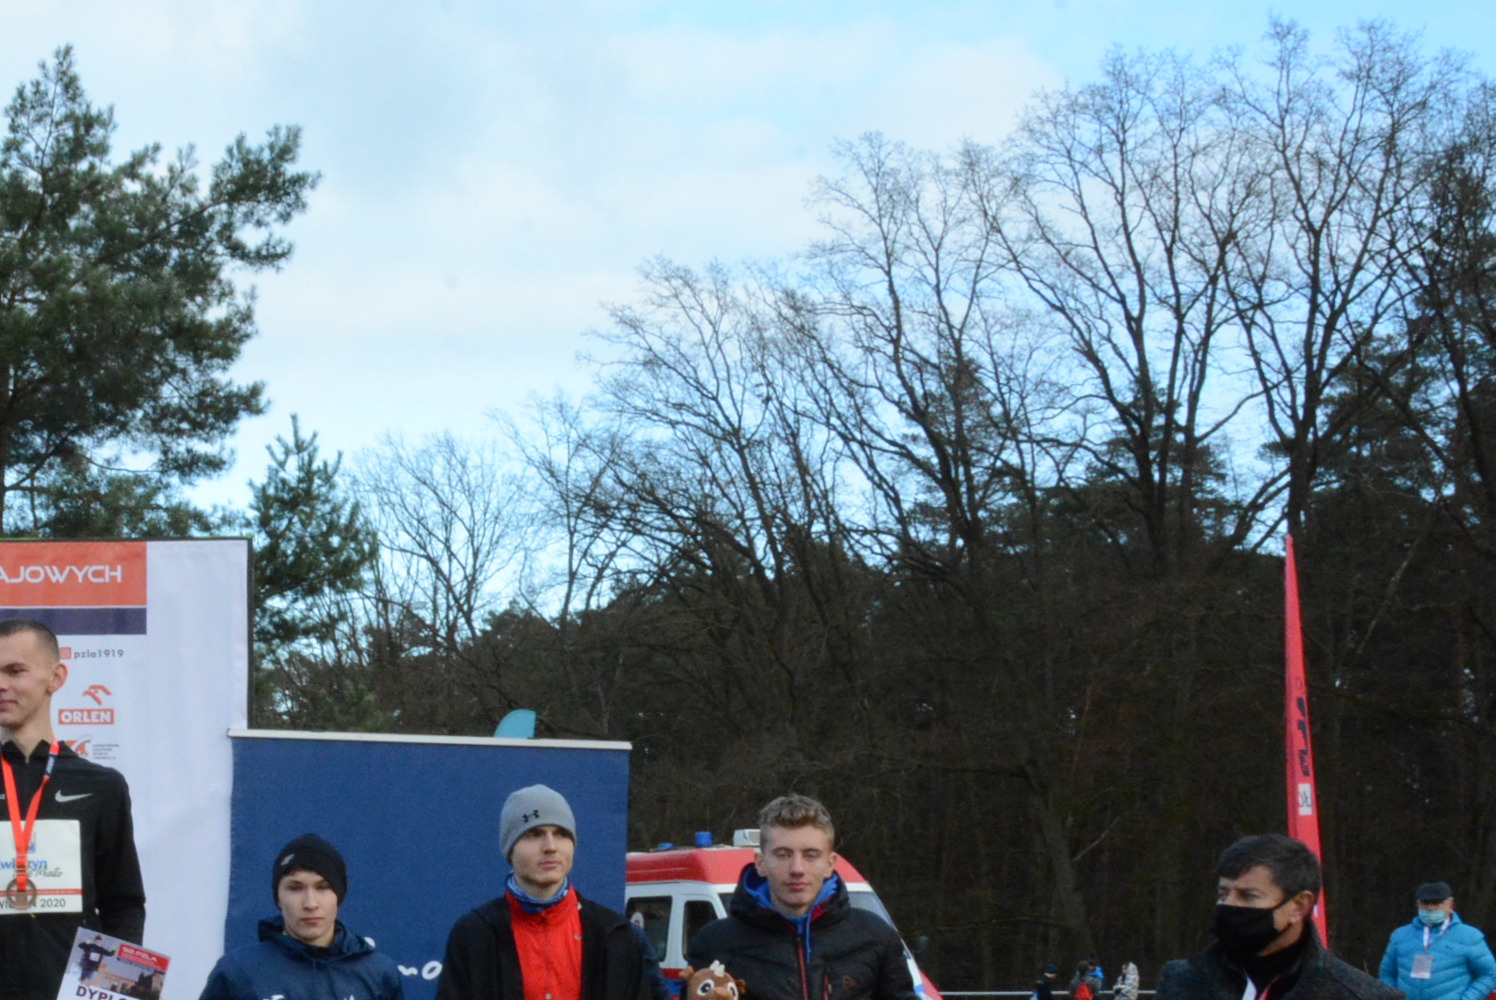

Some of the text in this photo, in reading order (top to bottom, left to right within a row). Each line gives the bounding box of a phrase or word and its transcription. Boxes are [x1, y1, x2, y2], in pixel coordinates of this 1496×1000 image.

[73, 649, 124, 661] pzla1919
[61, 710, 112, 723] ORLEN
[40, 898, 66, 908] 2020
